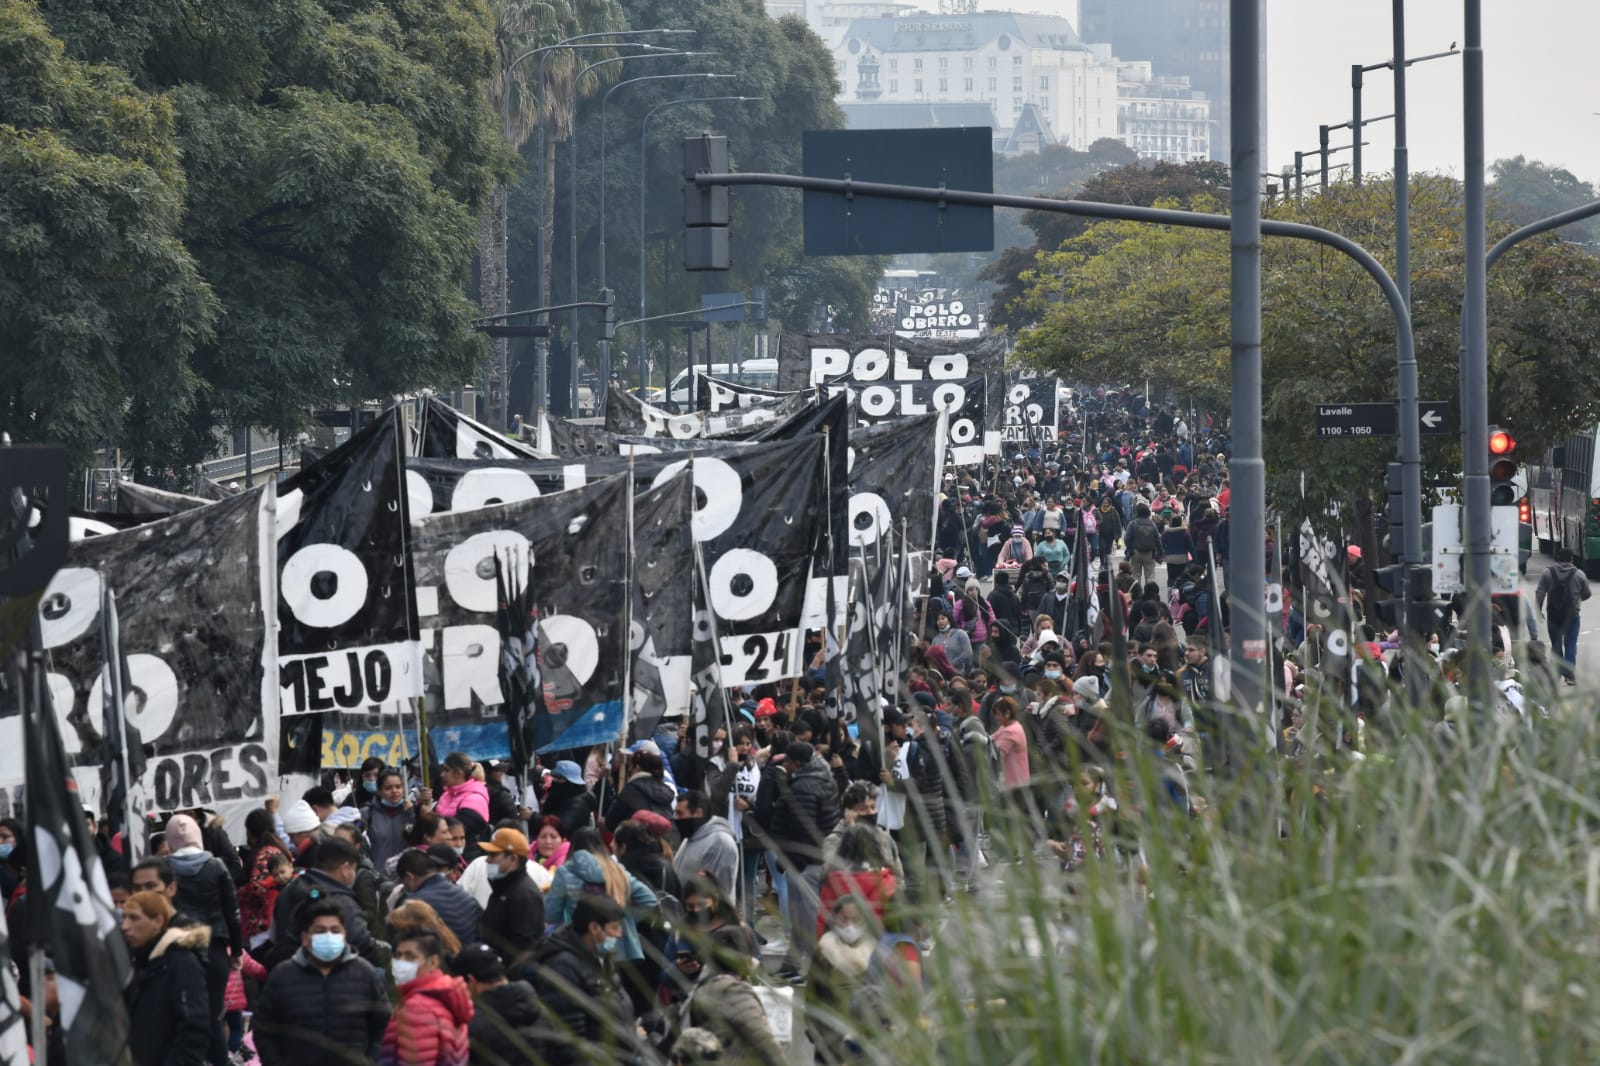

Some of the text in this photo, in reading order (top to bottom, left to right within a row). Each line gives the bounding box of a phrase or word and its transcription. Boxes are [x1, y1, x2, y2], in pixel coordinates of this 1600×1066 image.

[910, 301, 964, 318] POLO
[902, 313, 972, 330] OBRERO
[809, 348, 969, 388] POLO
[1320, 406, 1353, 416] Lavalle
[1321, 426, 1342, 436] 1100
[1350, 426, 1372, 435] 1050
[743, 633, 792, 682] 24
[145, 743, 269, 811] ORES
